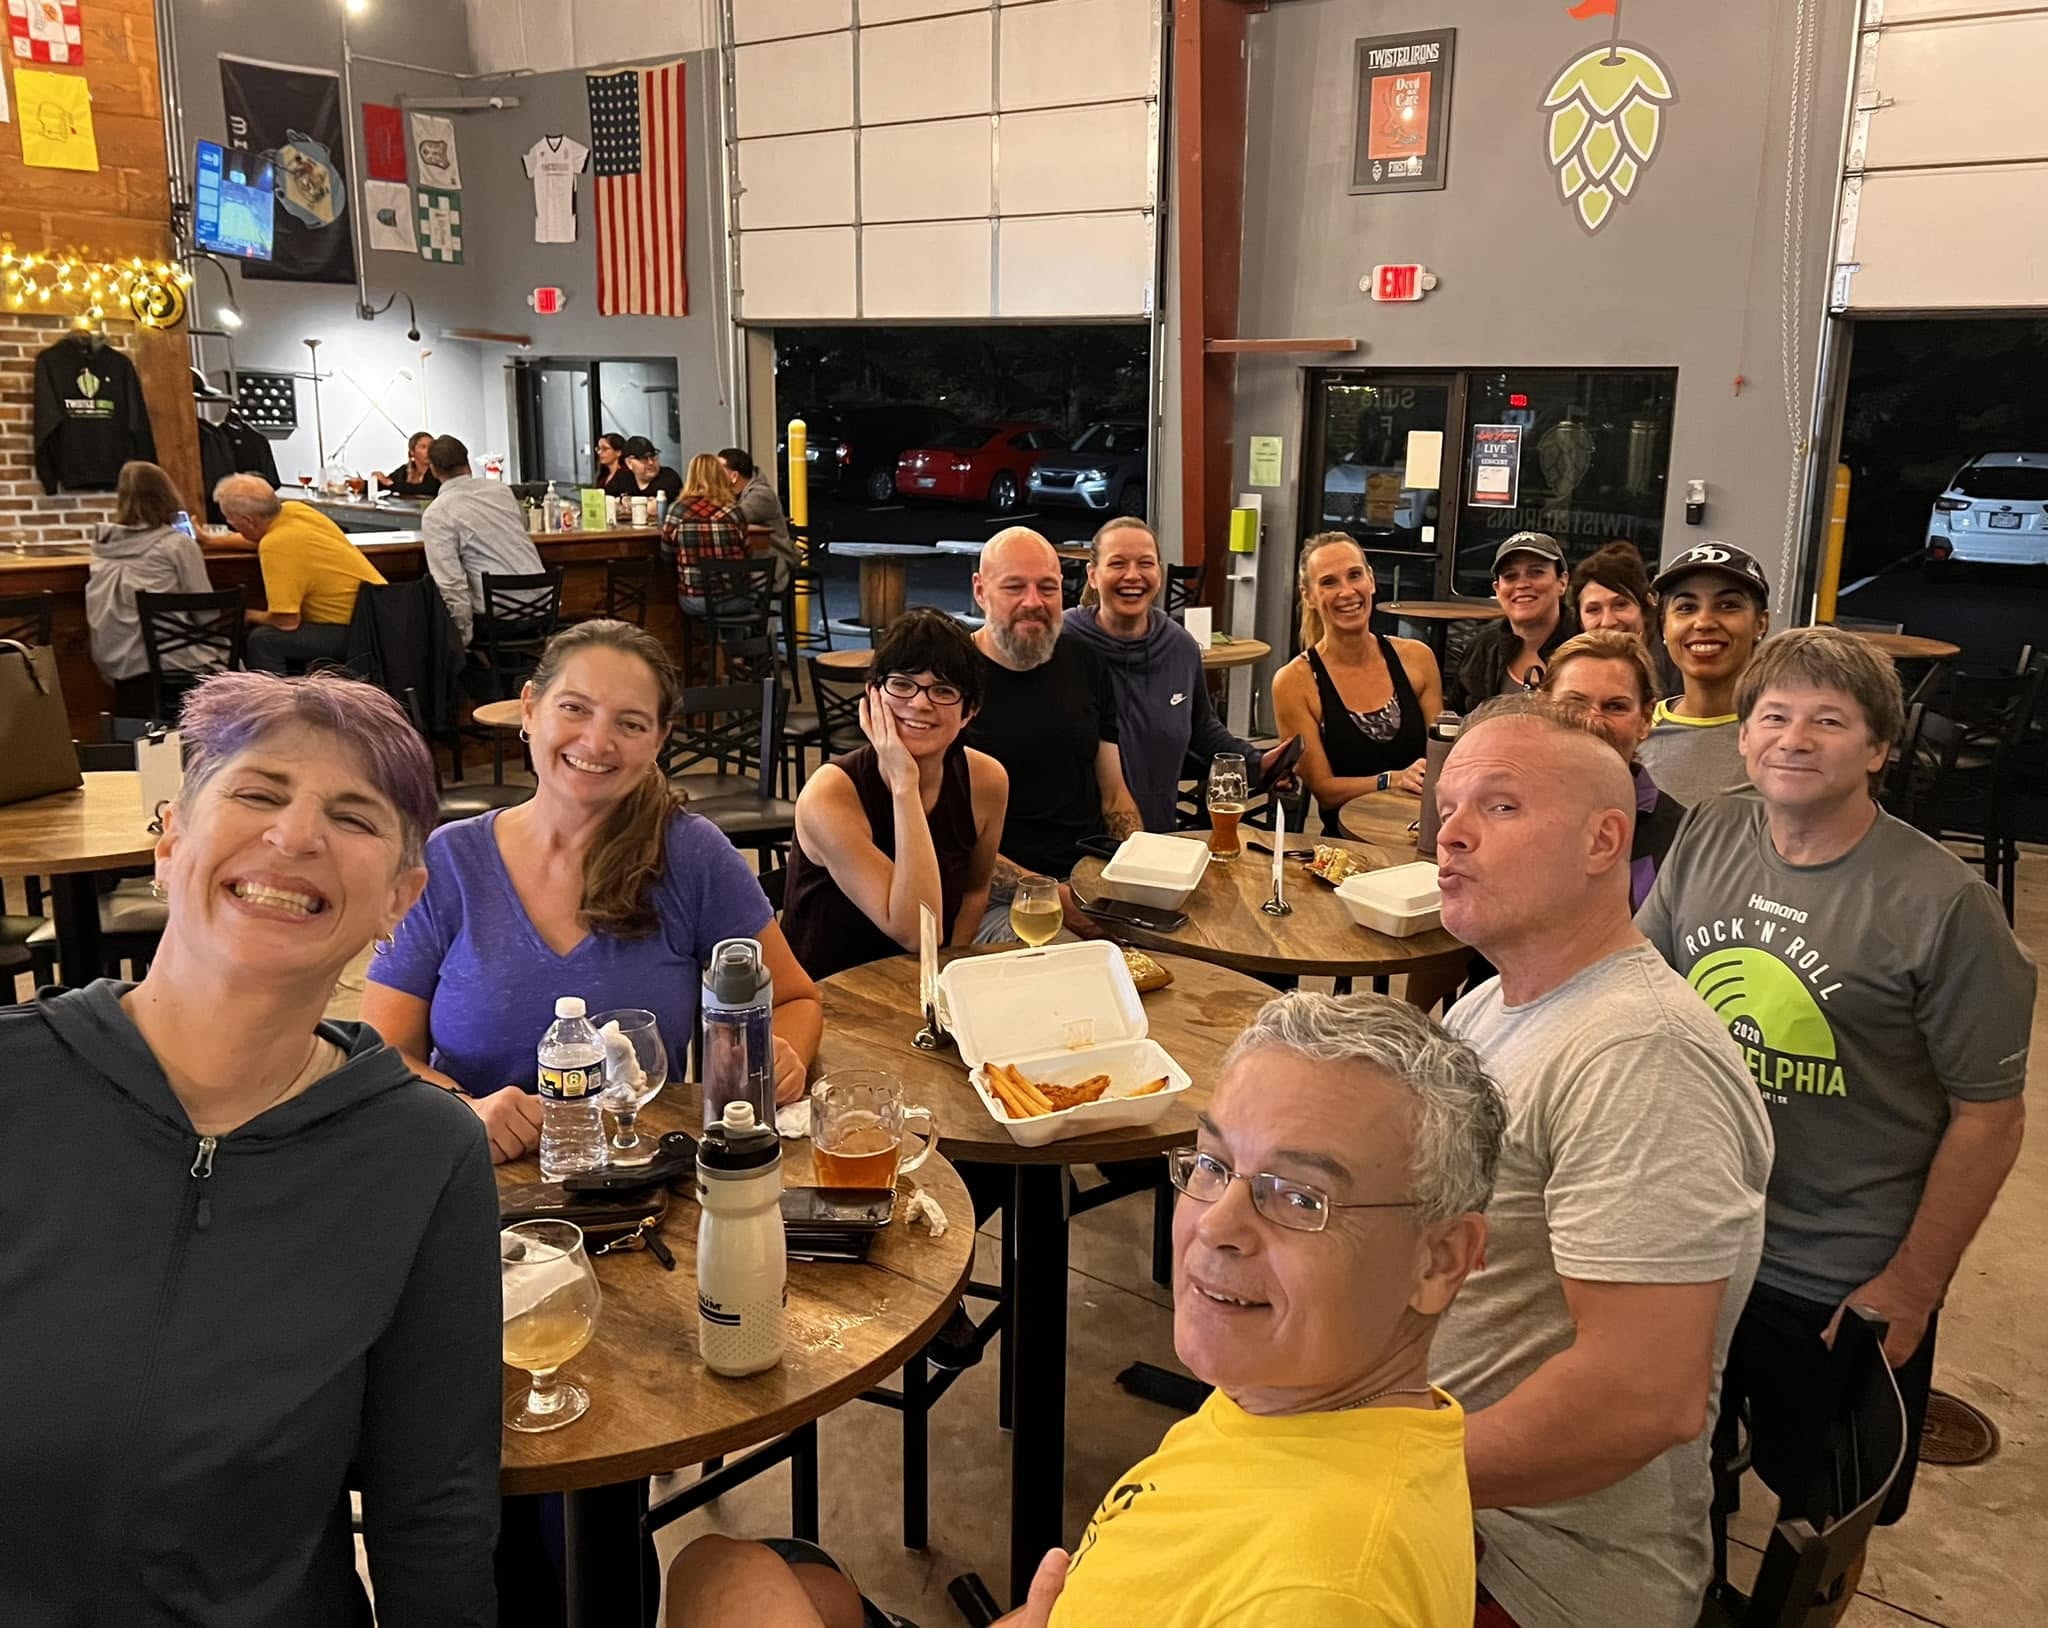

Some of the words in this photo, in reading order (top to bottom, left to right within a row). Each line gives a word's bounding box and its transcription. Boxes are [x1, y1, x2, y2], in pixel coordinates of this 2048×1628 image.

[1368, 46, 1410, 66] TWISTED
[1411, 43, 1440, 61] IRONS
[1381, 265, 1418, 298] EXIT
[1484, 443, 1508, 454] LIVE
[1747, 892, 1809, 924] Humana
[1685, 917, 1745, 956] ROCK
[1784, 935, 1843, 1001] ROLL
[1733, 1020, 1760, 1044] 2020
[1734, 1042, 1848, 1098] ELPHIA
